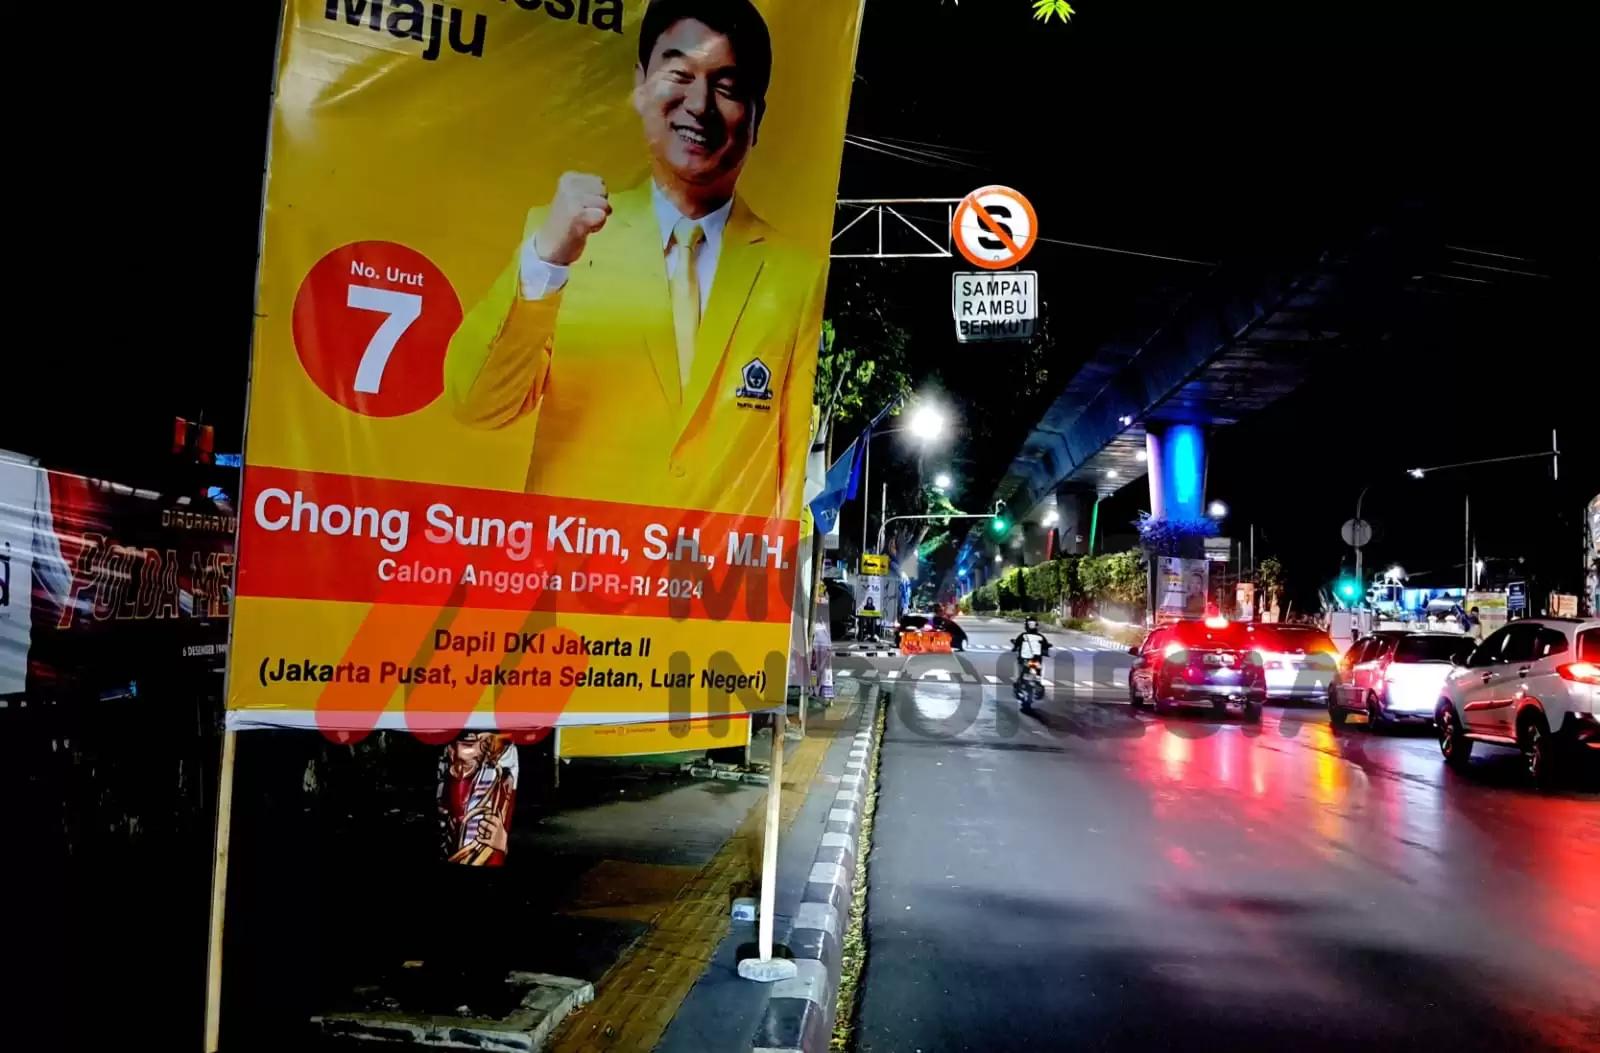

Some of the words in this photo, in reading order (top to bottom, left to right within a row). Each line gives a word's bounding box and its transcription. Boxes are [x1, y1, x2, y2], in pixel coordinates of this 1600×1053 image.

[351, 260, 380, 280] No.
[386, 266, 424, 287] Urut
[962, 281, 1027, 297] SAMPAI
[962, 300, 1027, 316] RAMBU
[347, 284, 423, 394] 7
[959, 320, 1030, 336] BERIKUT
[254, 488, 410, 552] Chong
[424, 503, 534, 561] Sung
[547, 515, 629, 563] Kim,
[643, 523, 716, 570] S.H.,
[726, 531, 789, 569] M.H.
[378, 558, 451, 585] Calon
[460, 564, 562, 594] Anggota
[571, 571, 650, 596] DPR-RI
[657, 578, 703, 600] 2024
[434, 629, 495, 657] Dapil
[503, 632, 545, 654] DKI
[551, 634, 632, 657] Jakarta
[639, 638, 651, 657] II
[259, 657, 371, 687] (Jakarta
[380, 661, 457, 688] Pusat,
[465, 664, 551, 687] Jakarta
[559, 666, 643, 691] Selatan,
[651, 668, 695, 689] Luar
[701, 669, 767, 693] Negeri)
